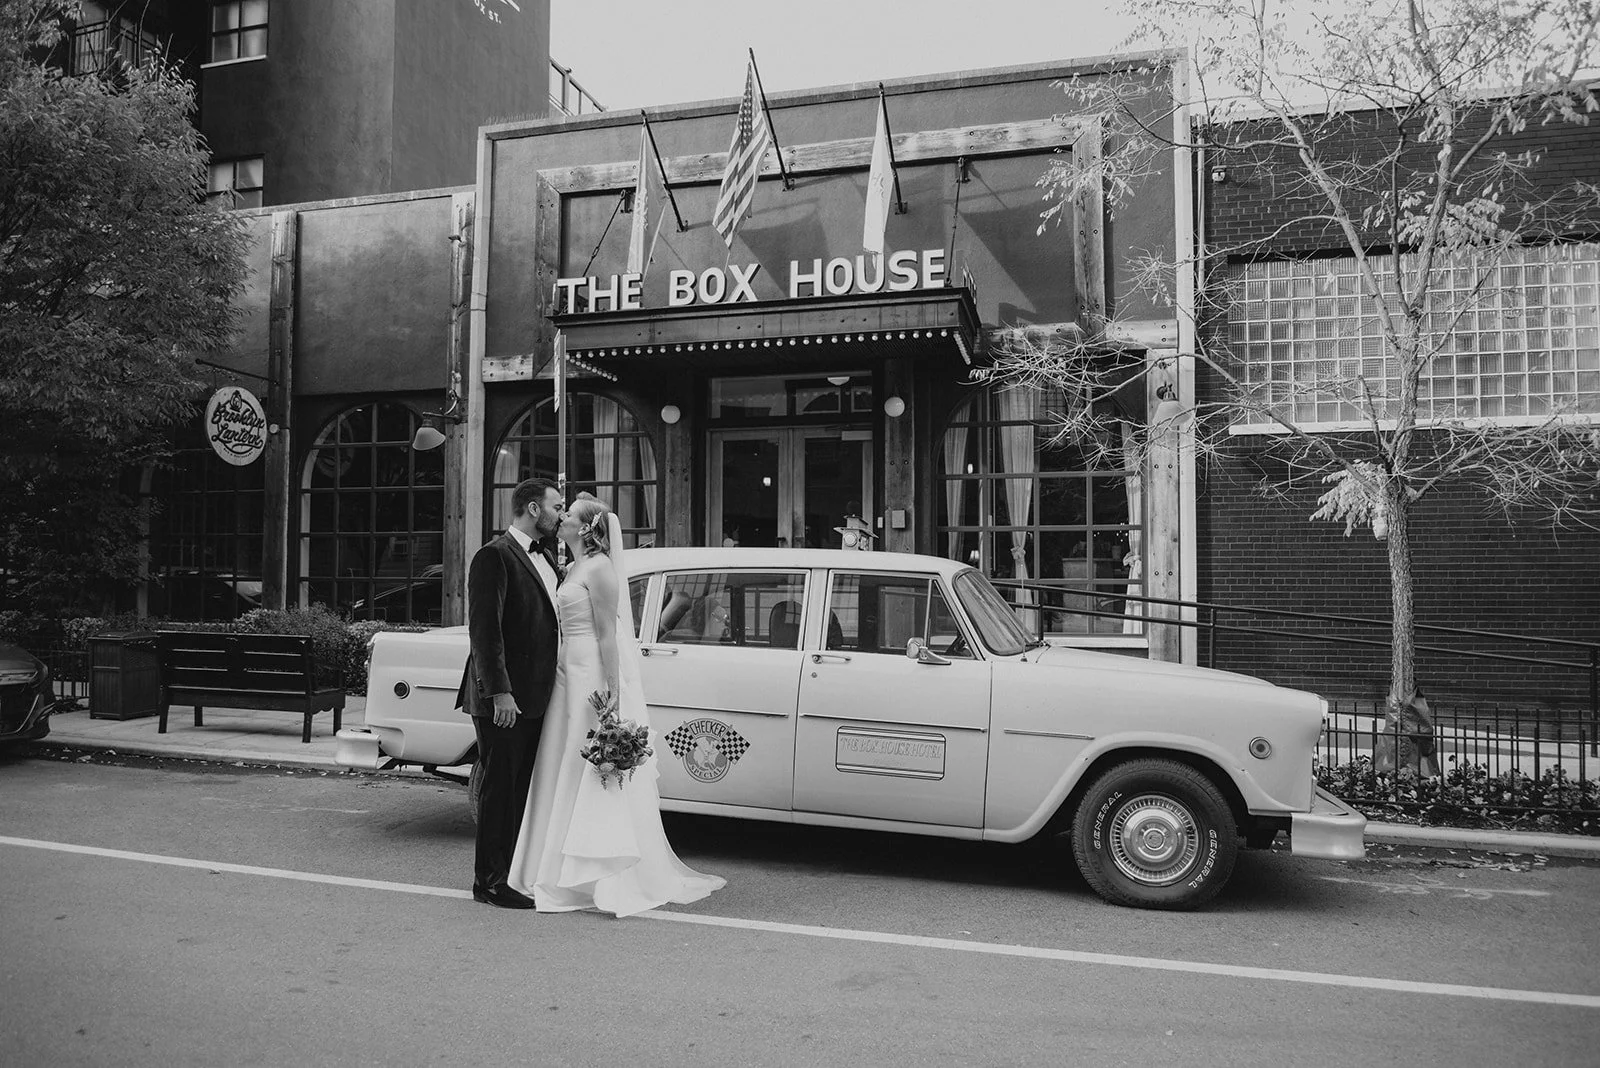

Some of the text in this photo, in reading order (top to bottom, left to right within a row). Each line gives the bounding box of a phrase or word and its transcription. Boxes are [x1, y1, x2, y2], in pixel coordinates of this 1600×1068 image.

[557, 248, 946, 314] THE BOX HOUSE
[211, 402, 265, 434] Brooklyn
[211, 423, 264, 449] Lantern
[689, 720, 727, 738] CHECKER
[691, 765, 722, 777] SPECIAL
[1093, 791, 1122, 850] GENERAL
[1188, 829, 1218, 888] GENERAL
